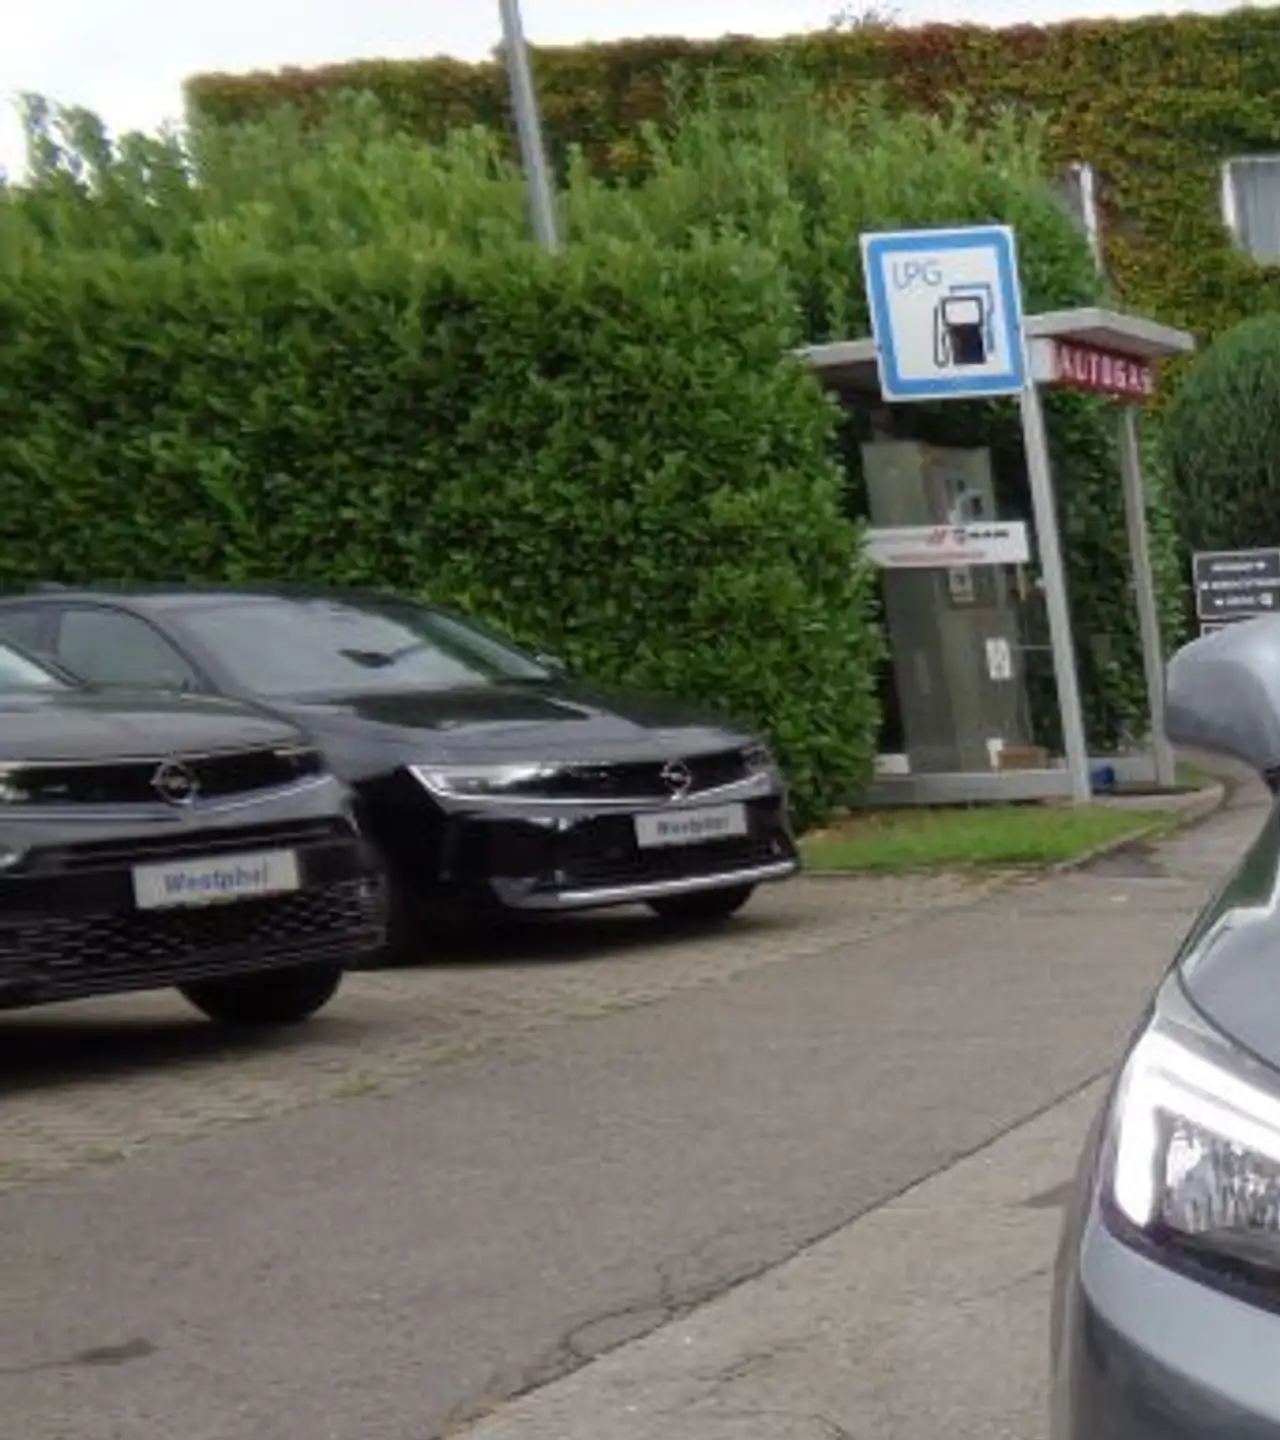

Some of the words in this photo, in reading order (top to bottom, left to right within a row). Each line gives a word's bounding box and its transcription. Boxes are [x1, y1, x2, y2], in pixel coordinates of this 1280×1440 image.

[891, 257, 943, 291] LPG
[1060, 343, 1154, 395] AUTOGAS
[164, 855, 268, 895] Westphal
